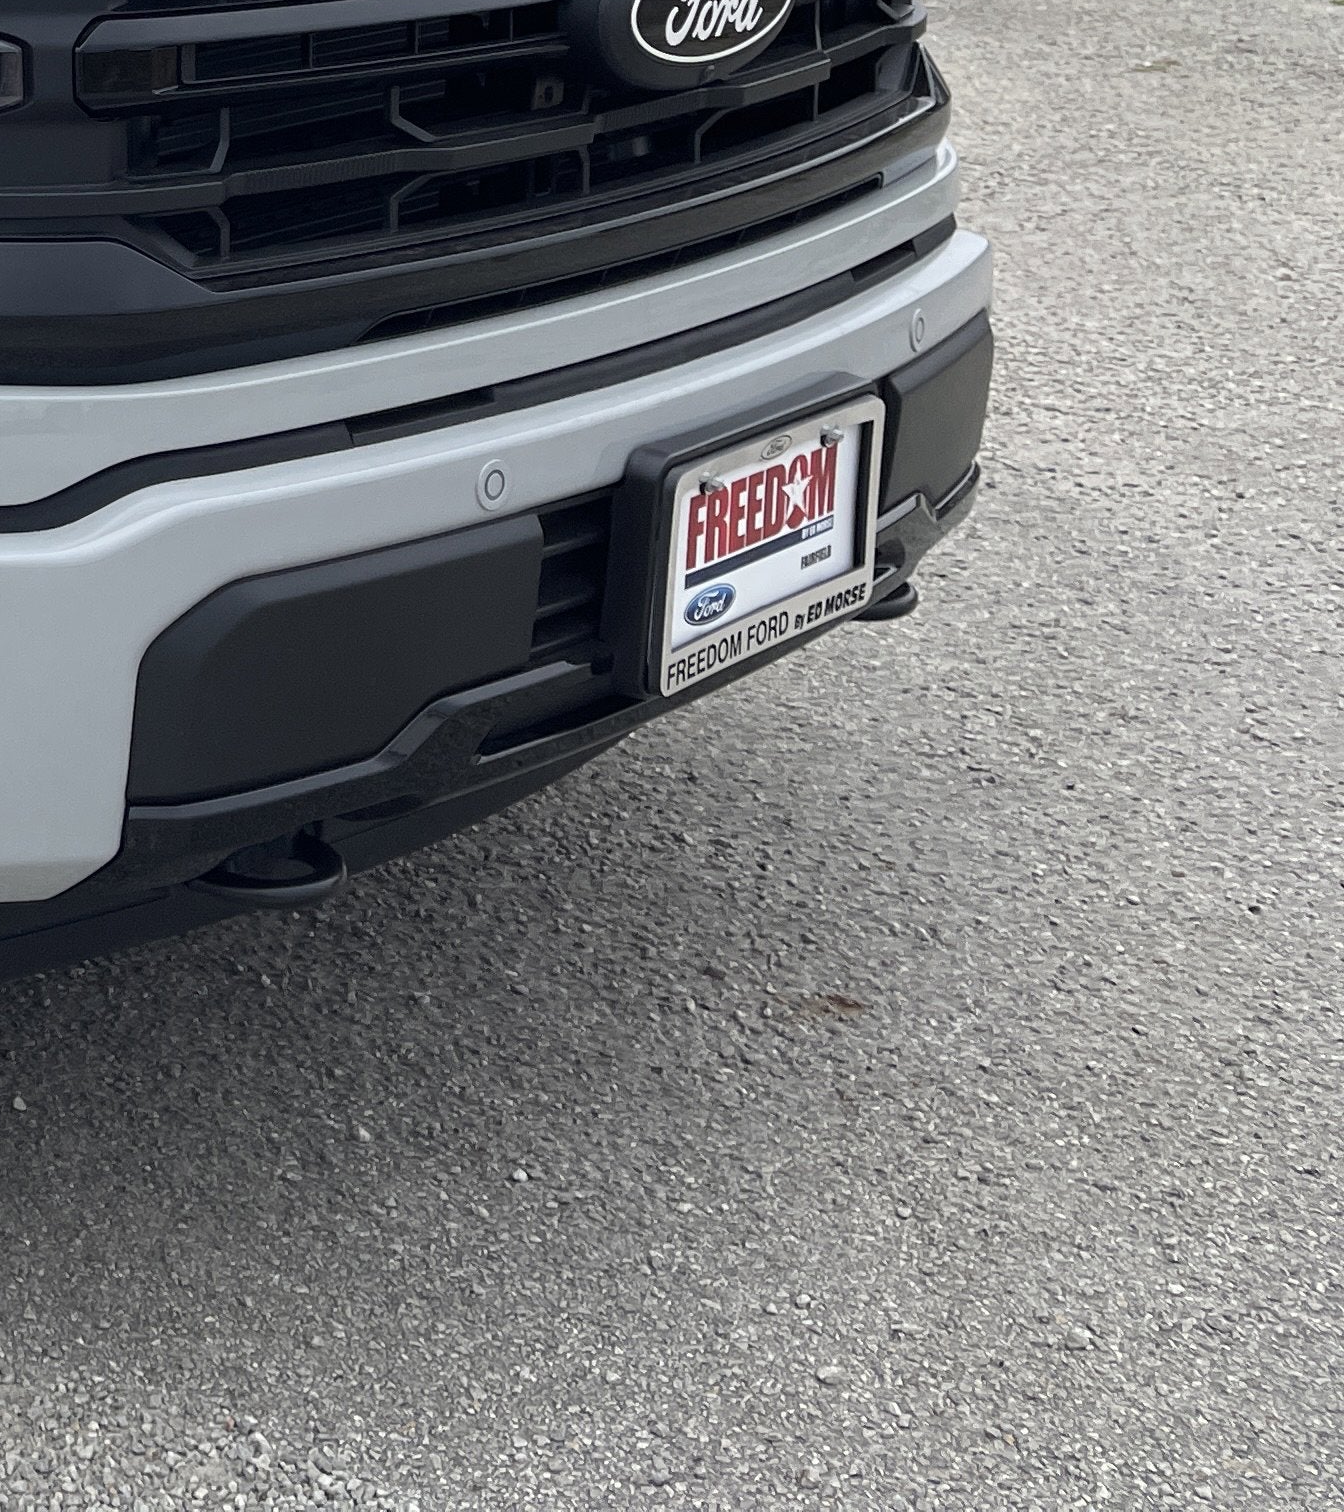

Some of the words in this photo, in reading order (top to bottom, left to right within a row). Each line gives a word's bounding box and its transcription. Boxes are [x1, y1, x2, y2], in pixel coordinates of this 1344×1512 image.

[686, 445, 838, 570] FREEDOM
[667, 631, 742, 690] FREEDOM
[747, 611, 789, 651] FORD
[807, 601, 823, 625] ED
[824, 582, 867, 617] MORSE
[694, 590, 728, 620] Ford
